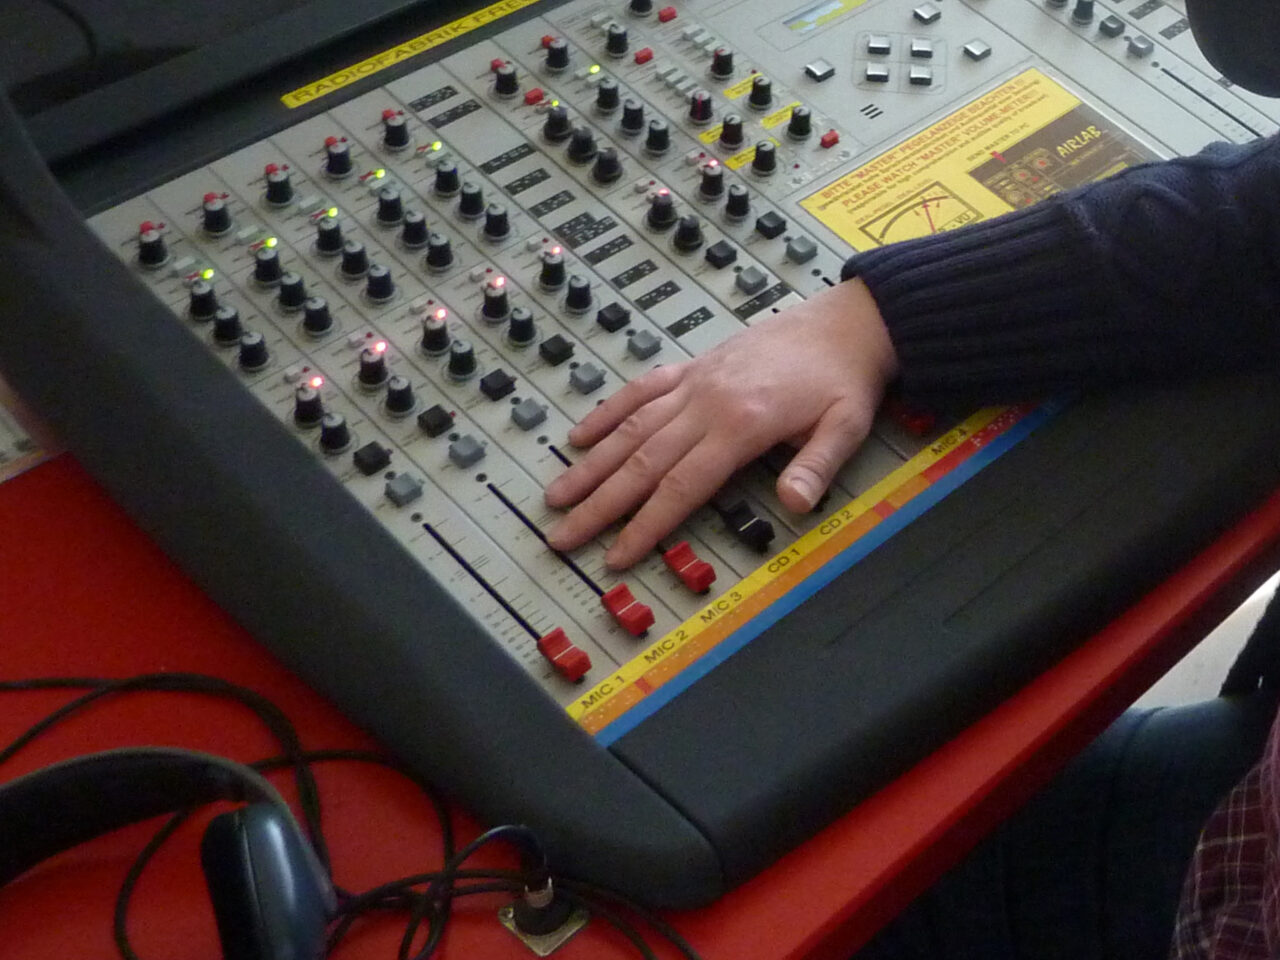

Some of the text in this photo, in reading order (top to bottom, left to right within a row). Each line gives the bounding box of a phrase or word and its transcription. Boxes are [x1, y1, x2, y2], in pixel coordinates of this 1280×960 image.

[291, 20, 469, 102] RADIOFABRIK
[821, 178, 852, 199] BITTE
[970, 83, 1016, 114] BEACHTEN
[1056, 125, 1102, 158] AIRLAB
[842, 182, 882, 207] PLEASE
[881, 161, 917, 184] WATCH
[931, 436, 956, 458] MIC
[819, 509, 854, 537] CD 2
[767, 554, 790, 574] CD
[700, 591, 742, 624] MIC 3
[643, 628, 689, 664] MIC 2
[581, 677, 615, 710] MIC
